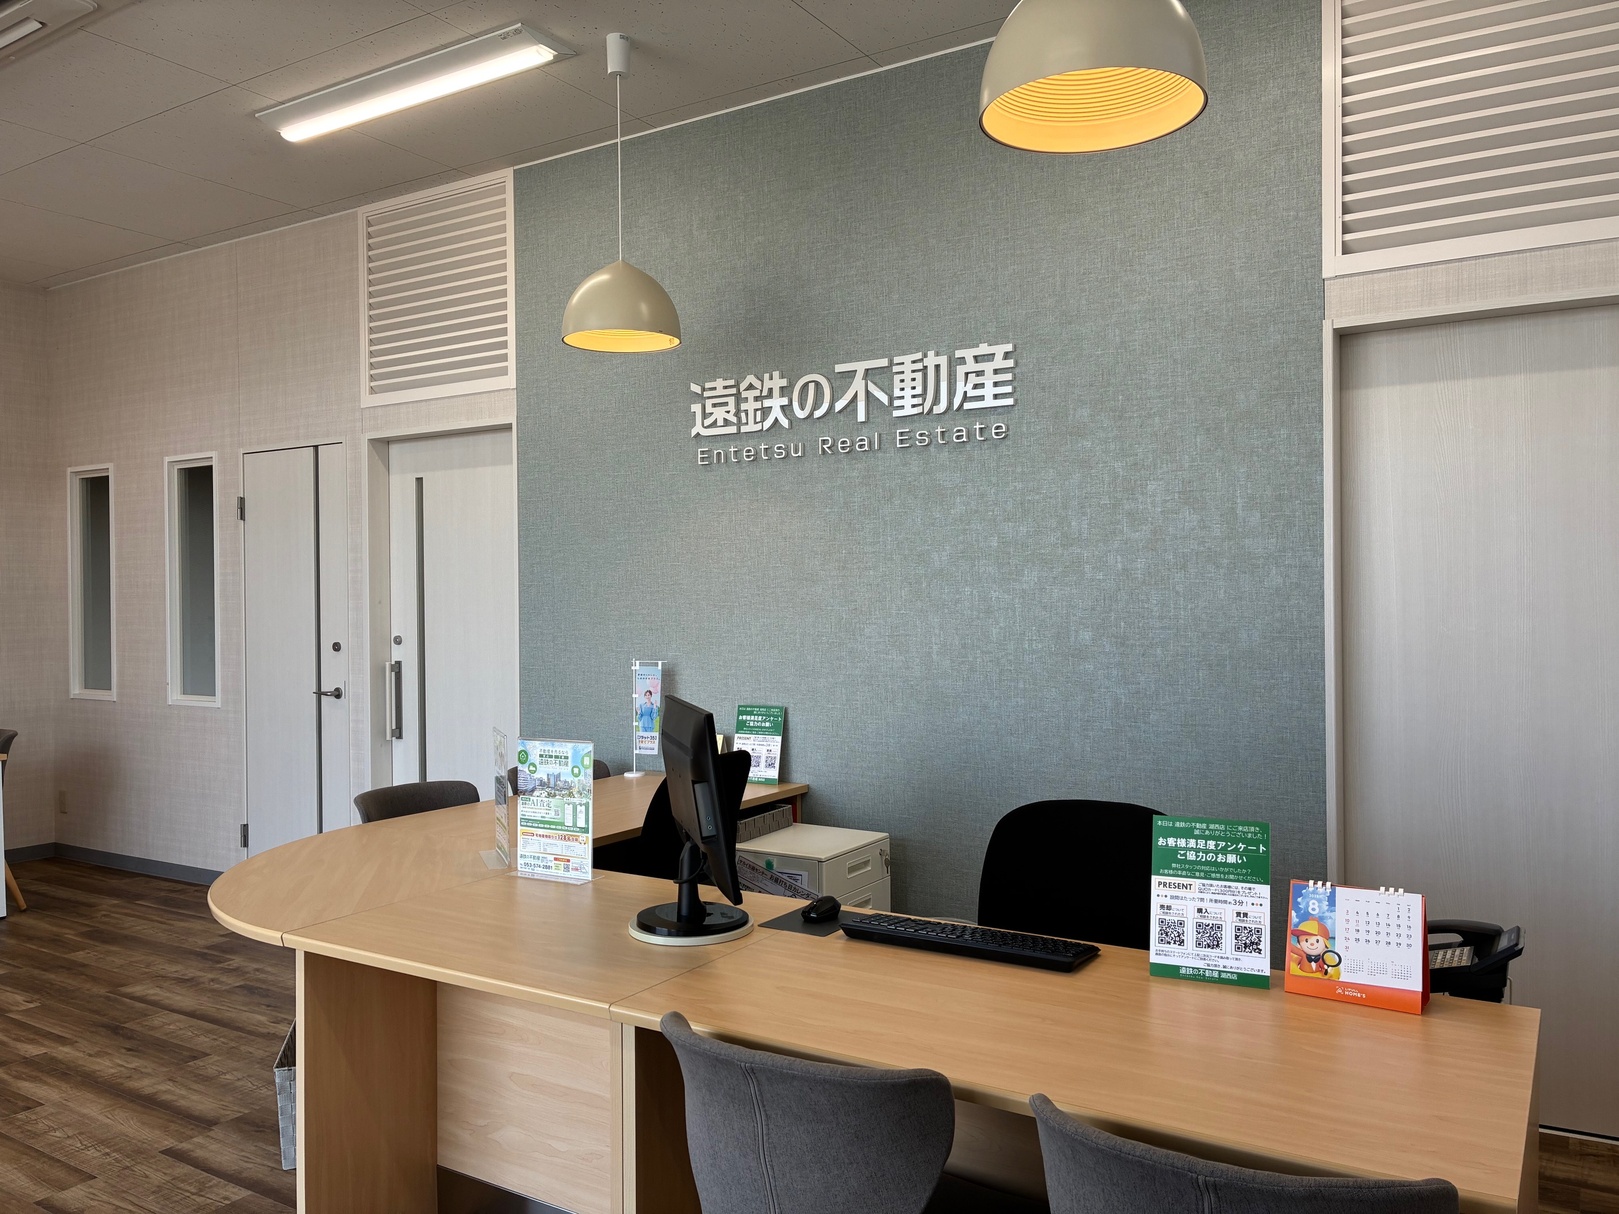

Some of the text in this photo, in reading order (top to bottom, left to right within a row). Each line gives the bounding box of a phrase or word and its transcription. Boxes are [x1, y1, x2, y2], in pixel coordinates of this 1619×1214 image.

[690, 343, 1015, 438] 遠鉄の不動産
[697, 422, 1009, 466] Entetsu Real Estate
[1174, 821, 1207, 829] 遠鉄の不動産
[1157, 837, 1267, 854] お客様満足度アンケート
[1177, 850, 1247, 864] ご協力のお願い
[1157, 881, 1193, 890] PRESENT
[1308, 900, 1319, 914] 8
[1179, 966, 1219, 978] 遠鉄の不動産
